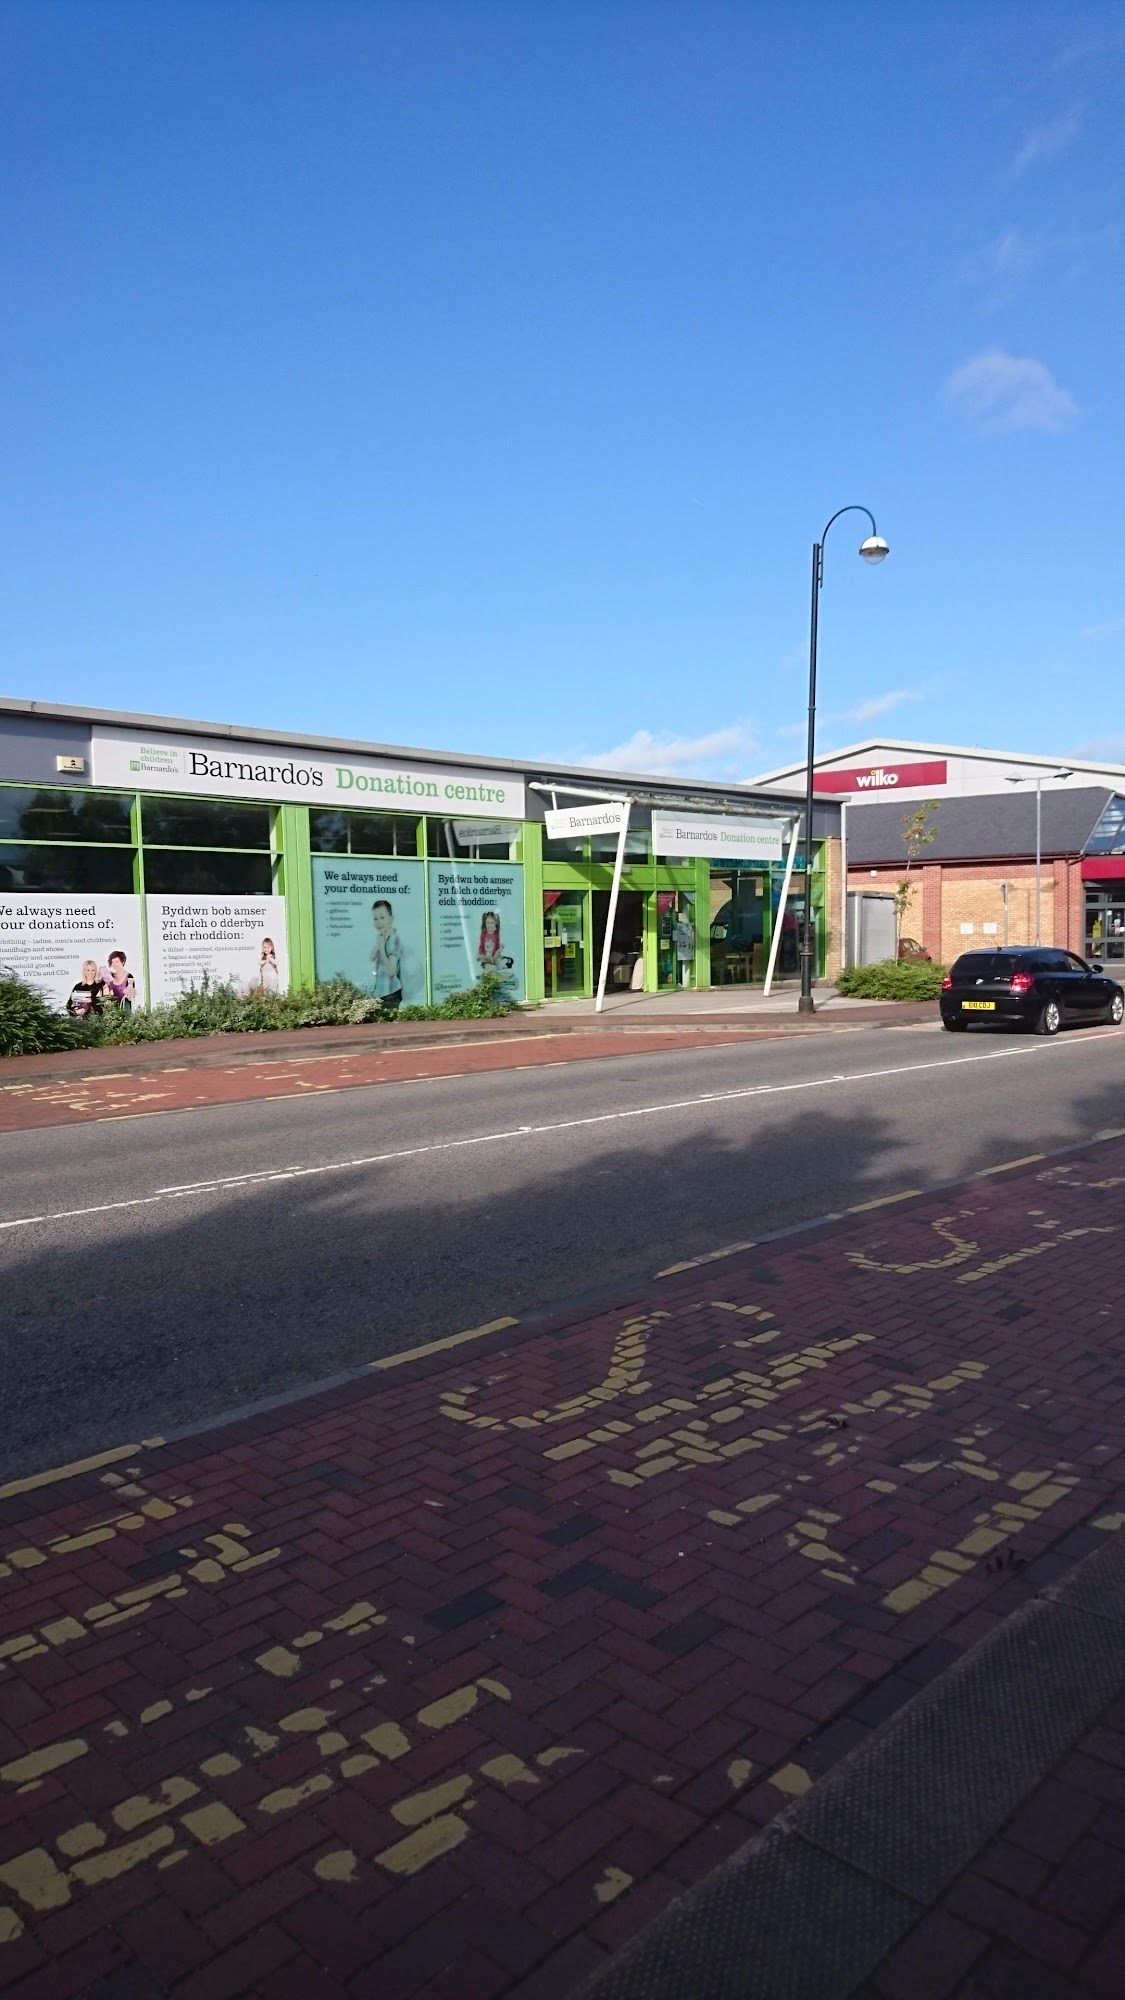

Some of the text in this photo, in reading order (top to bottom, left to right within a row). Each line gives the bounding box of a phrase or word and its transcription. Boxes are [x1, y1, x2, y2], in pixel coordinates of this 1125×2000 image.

[140, 746, 168, 756] Believe
[140, 755, 173, 764] children
[141, 763, 179, 774] Barnardo's
[189, 753, 506, 803] Barnardo's Donation centre
[856, 769, 899, 787] wilko
[569, 813, 621, 828] Barnardo's
[676, 828, 718, 841] Barnardo's
[720, 832, 755, 844] Donation
[756, 834, 780, 845] centre
[324, 871, 398, 883] We always need
[438, 874, 472, 885] Byddwn
[473, 875, 489, 884] bob
[324, 884, 411, 895] your donations of:
[438, 888, 450, 897] yn
[451, 886, 471, 895] falch
[479, 887, 512, 897] dderbyn
[438, 897, 456, 906] eich
[16, 905, 62, 919] always
[65, 906, 96, 916] need
[161, 906, 267, 918] Byddwn bob amser
[0, 919, 114, 930] our donations of:
[161, 918, 264, 931] yn falch o dderbyn
[162, 930, 244, 941] eich rhoddion:
